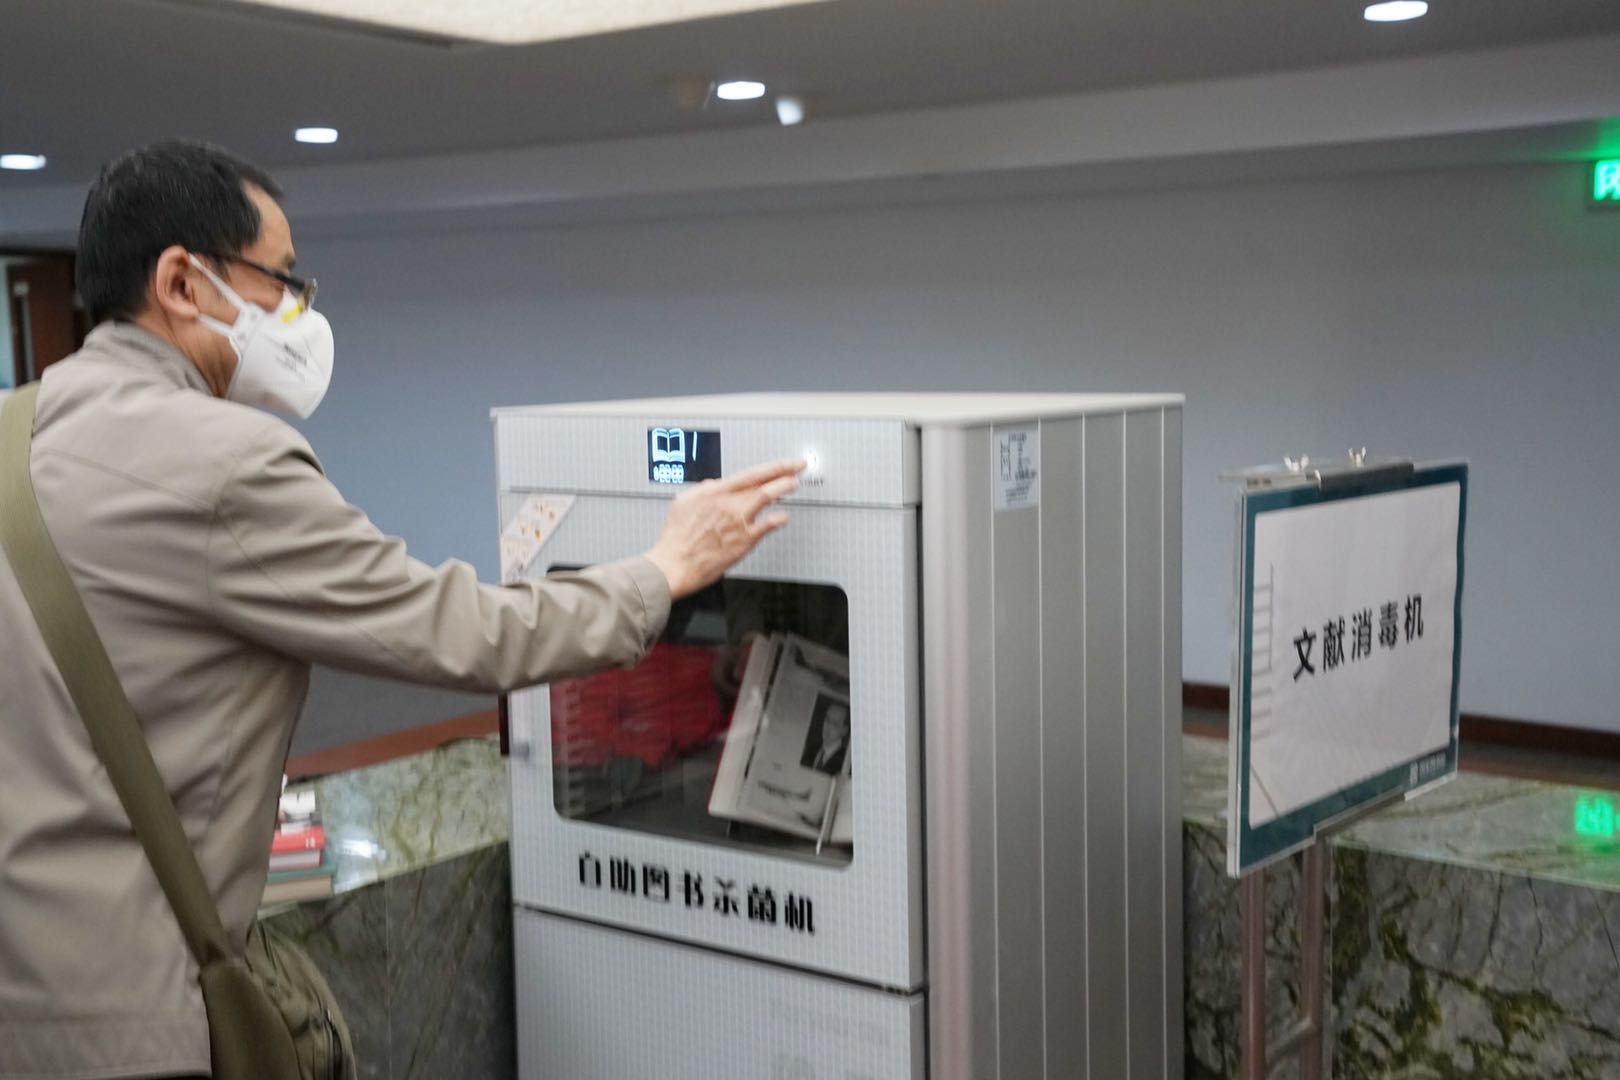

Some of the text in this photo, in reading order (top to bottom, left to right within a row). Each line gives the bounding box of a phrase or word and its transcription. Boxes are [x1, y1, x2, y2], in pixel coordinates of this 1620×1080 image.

[1293, 593, 1424, 682] 文献消毒机
[579, 850, 815, 936] 自助图书杀菌机
